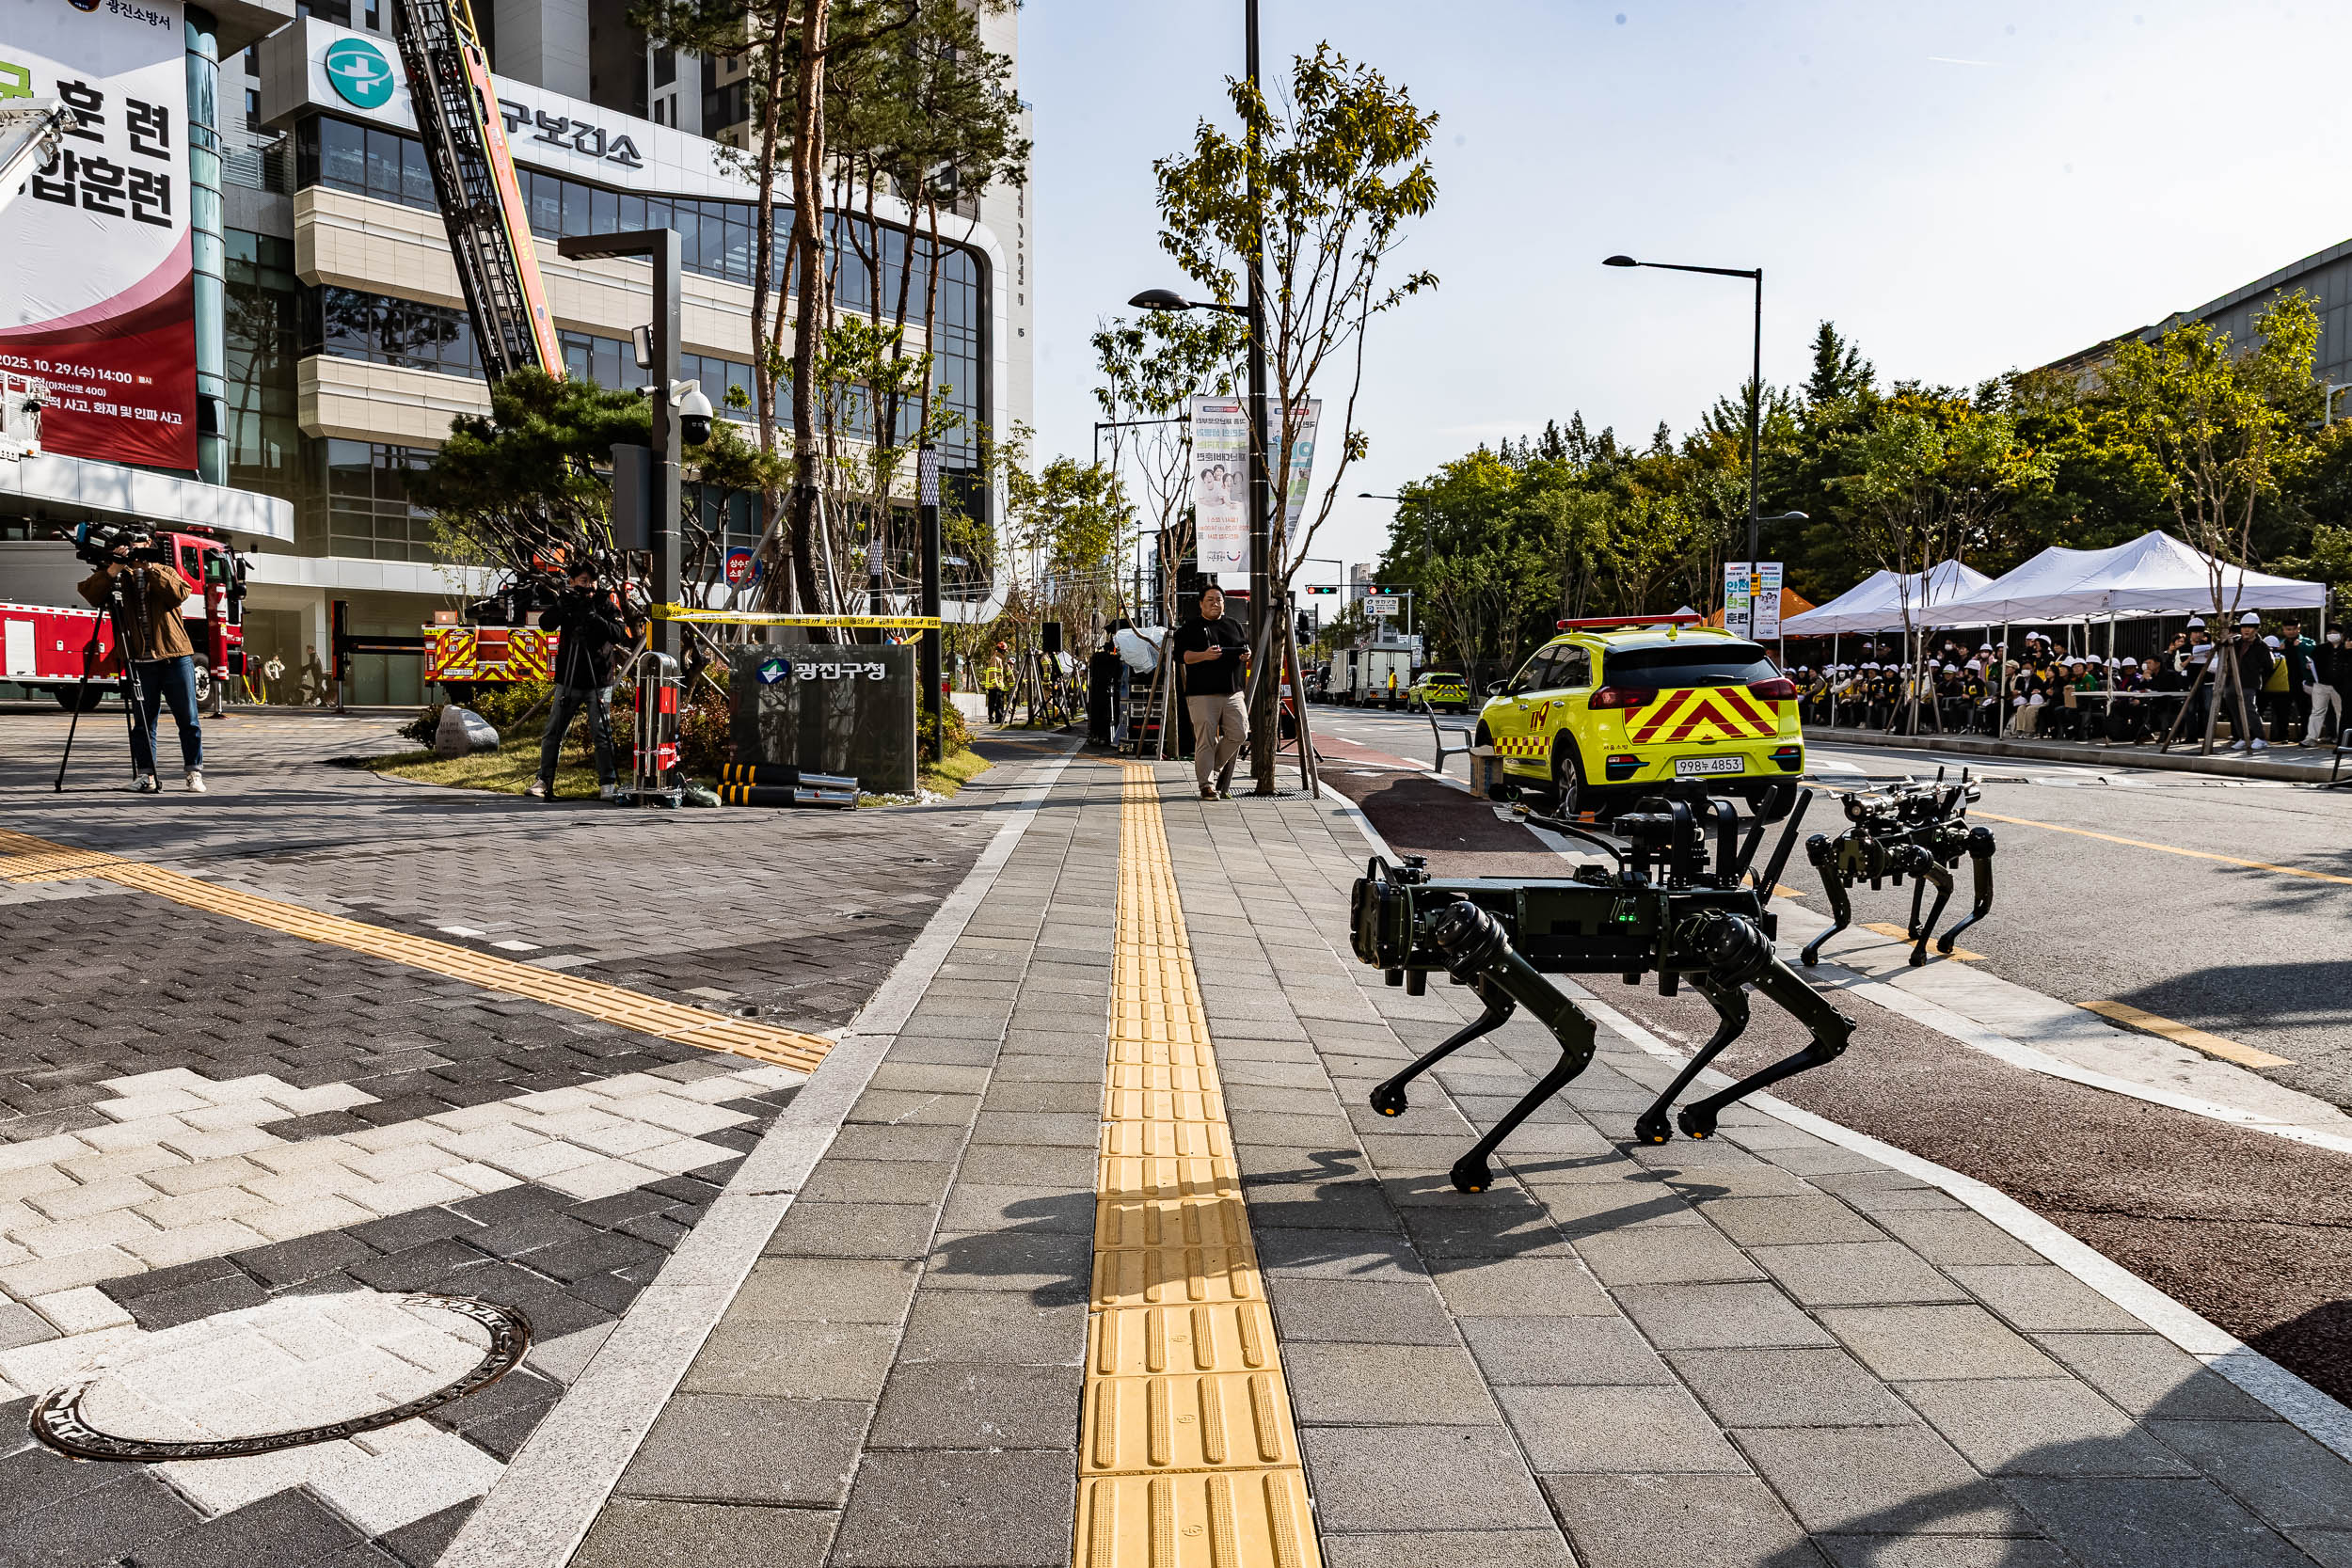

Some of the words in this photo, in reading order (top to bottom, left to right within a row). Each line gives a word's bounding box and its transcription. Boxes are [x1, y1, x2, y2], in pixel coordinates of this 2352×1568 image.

[106, 0, 170, 30] 광진소방서
[126, 98, 171, 162] 련
[498, 98, 644, 168] 구보건소
[18, 148, 173, 230] 합훈련
[34, 360, 53, 372] 10.
[98, 369, 132, 384] 14:00
[85, 387, 106, 397] 400)
[65, 401, 91, 414] 사고,
[94, 403, 117, 416] 화재
[120, 406, 133, 419] 및
[135, 408, 157, 421] 인파
[160, 411, 183, 425] 사고
[795, 662, 885, 680] 광진구청
[1530, 700, 1550, 731] 119
[1680, 760, 1709, 772] 998누
[1712, 759, 1740, 770] 4853
